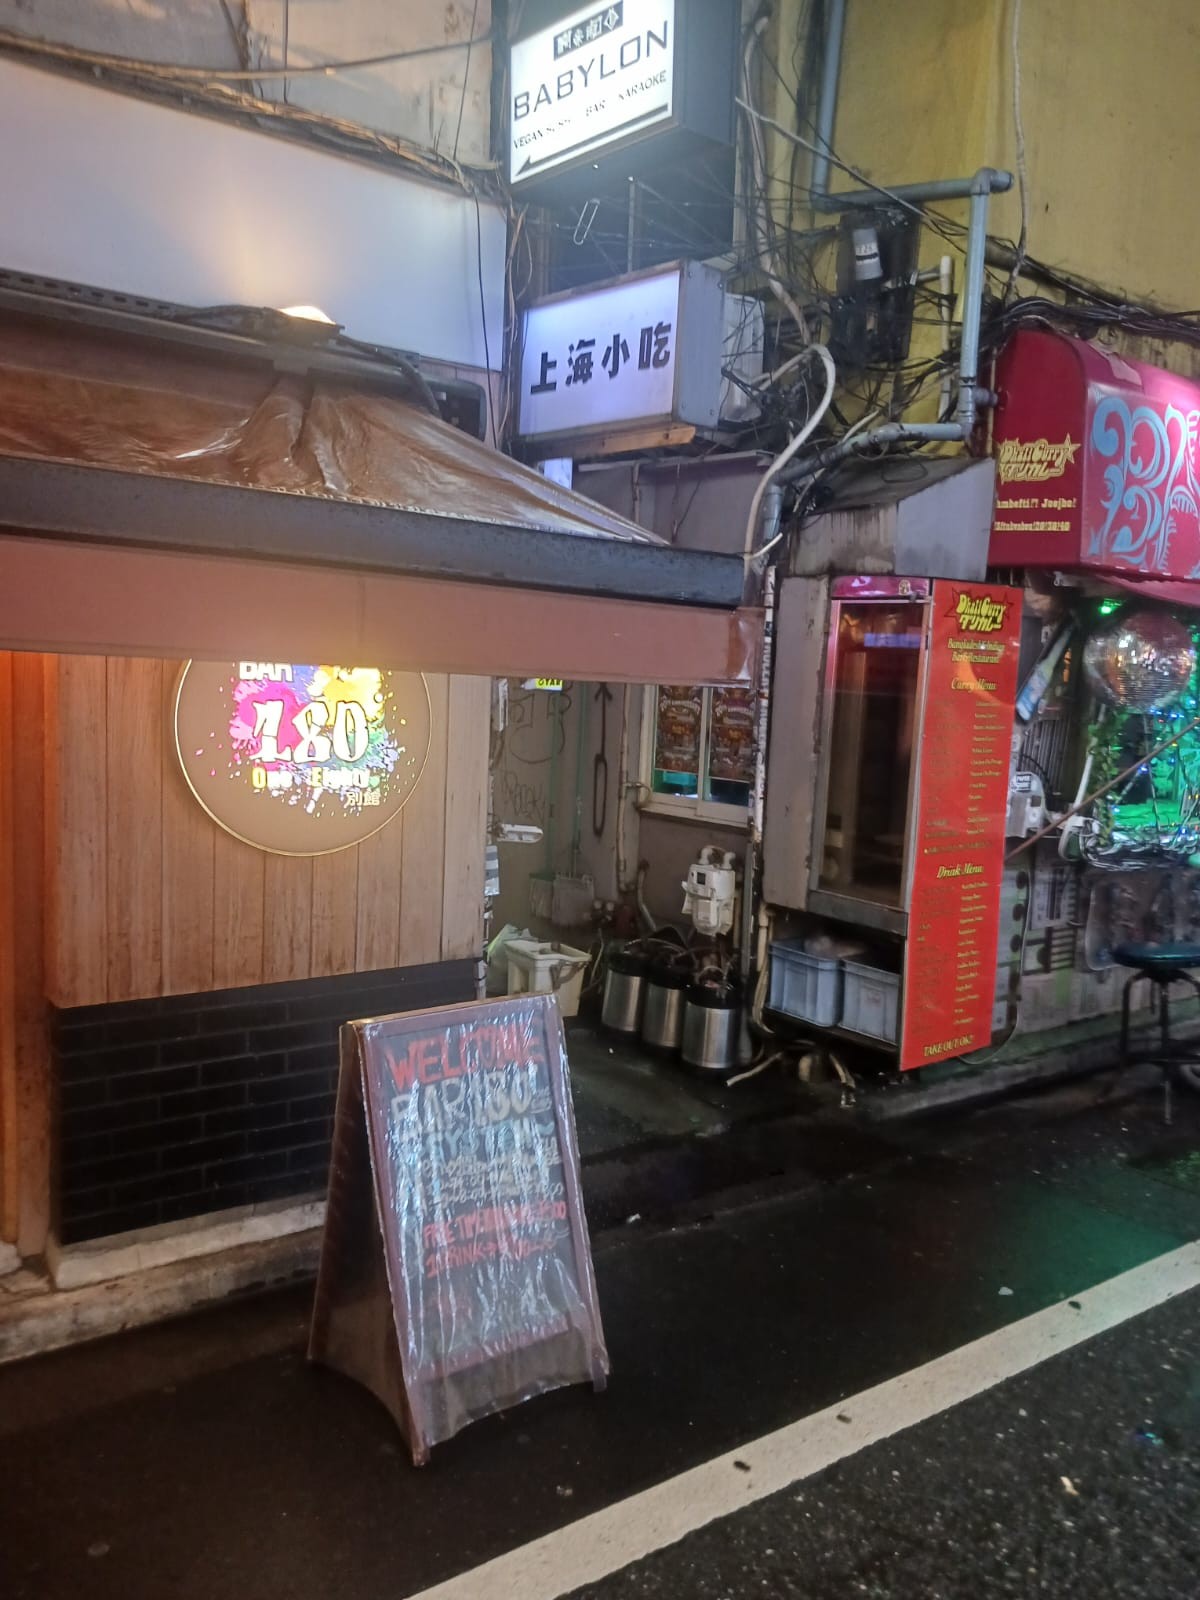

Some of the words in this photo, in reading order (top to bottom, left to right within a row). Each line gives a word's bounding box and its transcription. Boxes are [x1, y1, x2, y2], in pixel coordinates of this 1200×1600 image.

[513, 20, 668, 121] BABYLON
[530, 321, 672, 395] 上海小吃
[250, 700, 369, 763] 180
[344, 791, 380, 808] 別館
[385, 1023, 545, 1093] WELCOME
